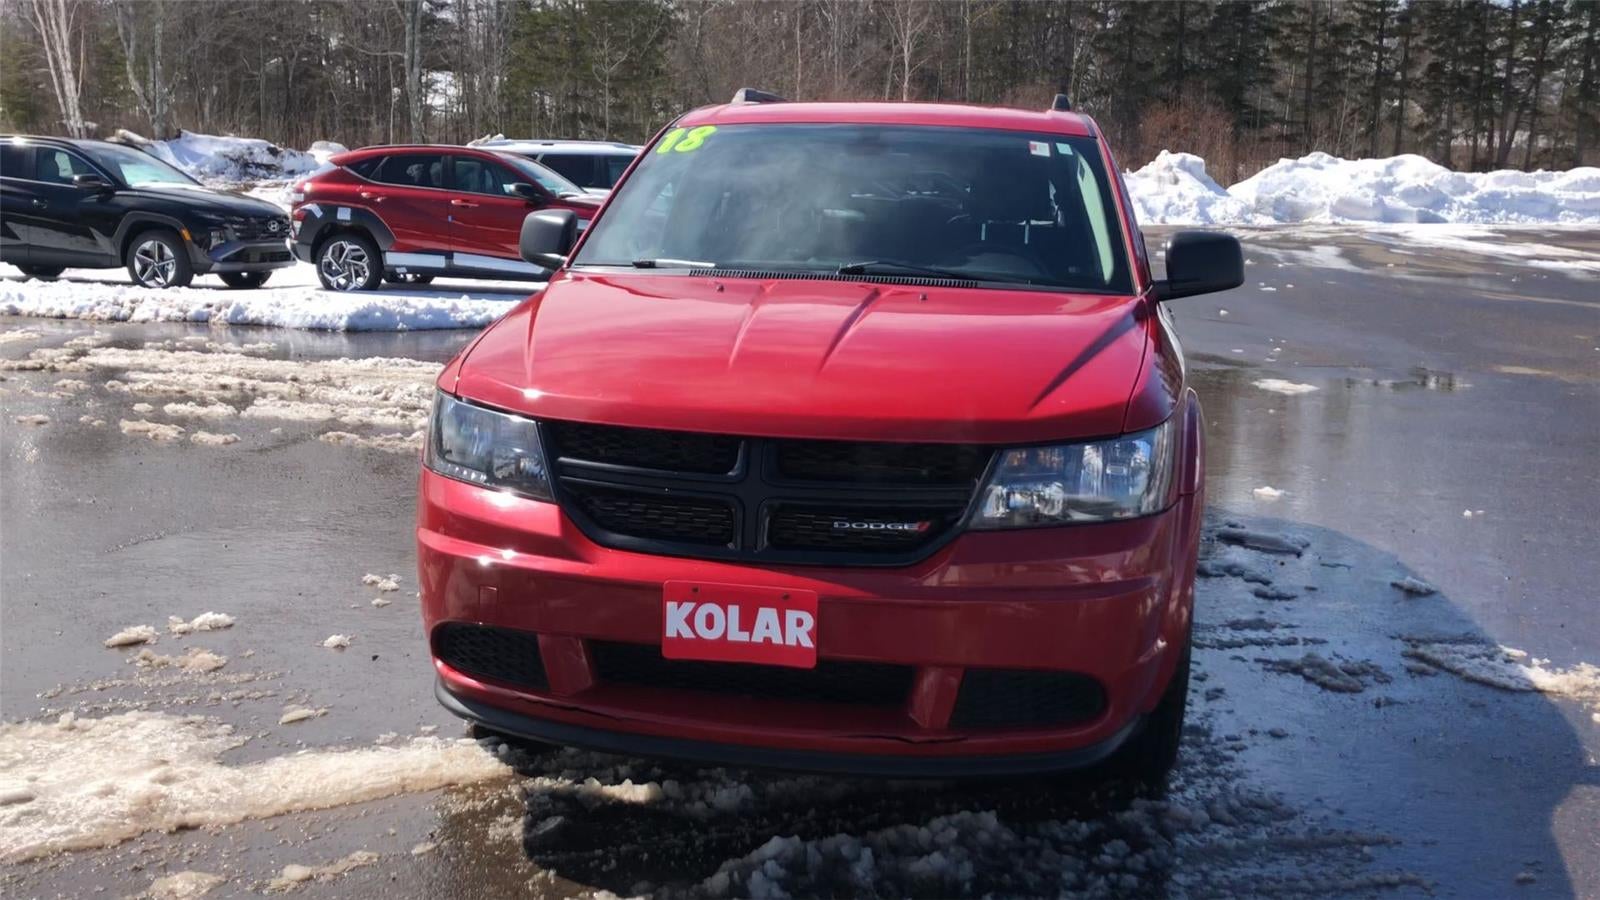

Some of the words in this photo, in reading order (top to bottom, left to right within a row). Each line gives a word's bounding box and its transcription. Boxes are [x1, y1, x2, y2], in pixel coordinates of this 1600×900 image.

[656, 125, 717, 154] 18
[833, 521, 919, 530] DODGE
[665, 601, 815, 649] KOLAR
